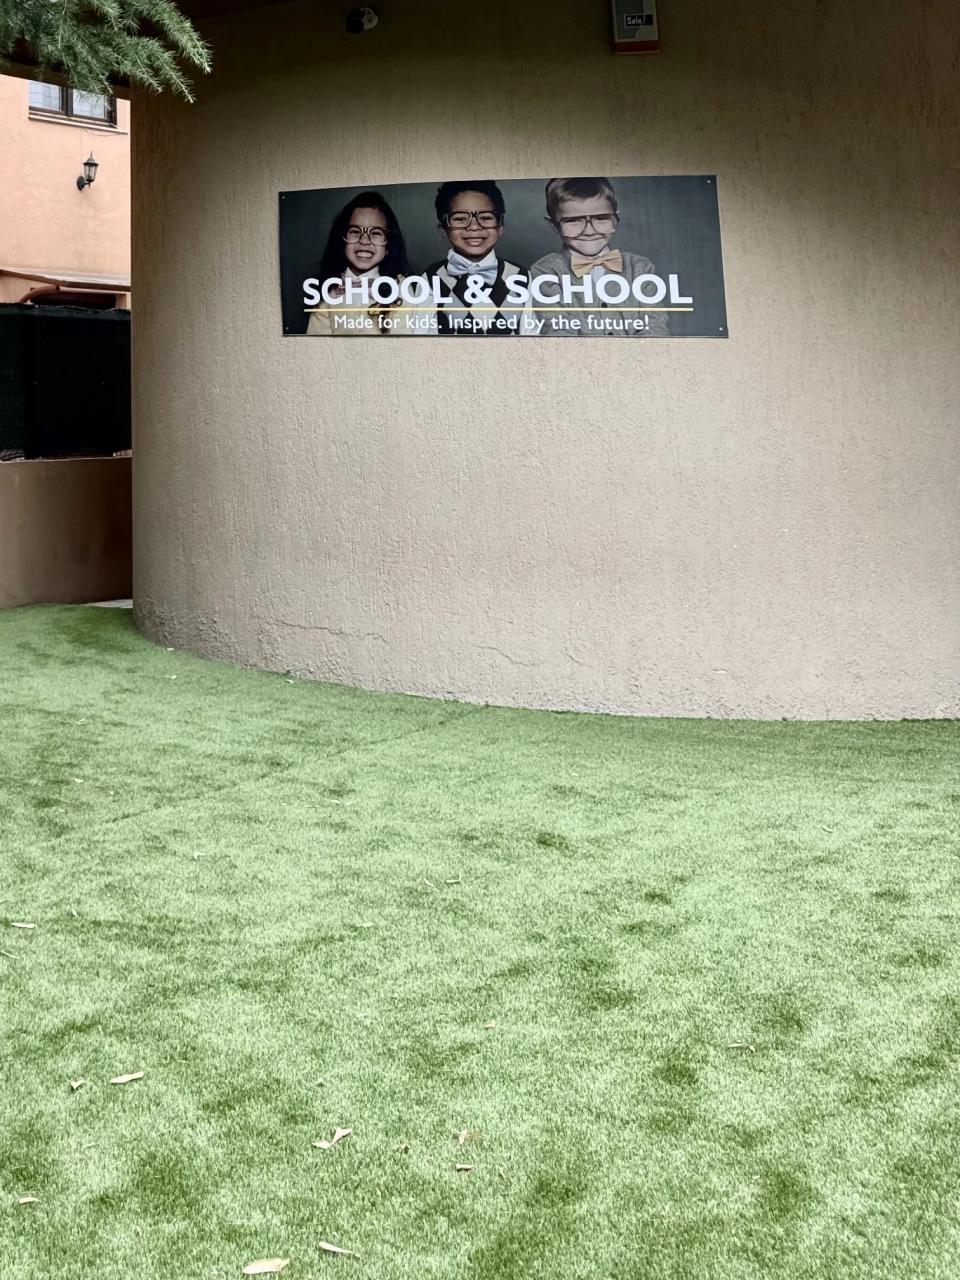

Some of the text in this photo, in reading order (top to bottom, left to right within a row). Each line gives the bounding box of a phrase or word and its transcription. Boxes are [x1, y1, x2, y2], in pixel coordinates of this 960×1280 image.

[302, 273, 693, 305] SCHOOL & SCHOOL
[334, 314, 650, 333] Made for kids. Inspired by the future!
